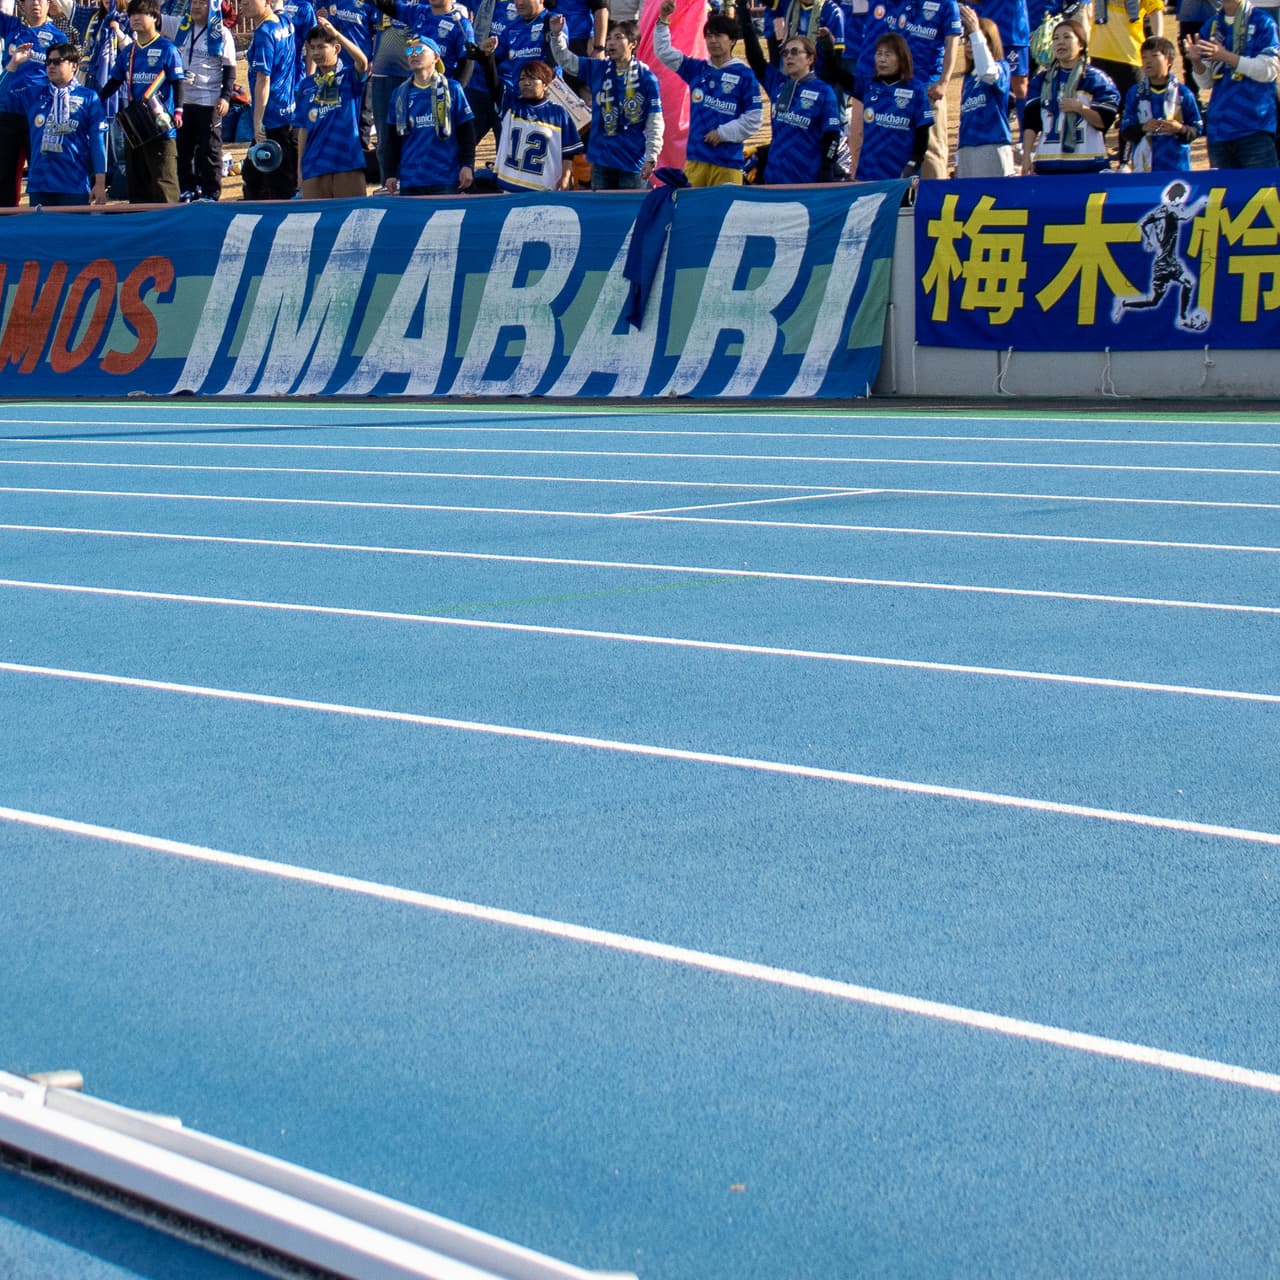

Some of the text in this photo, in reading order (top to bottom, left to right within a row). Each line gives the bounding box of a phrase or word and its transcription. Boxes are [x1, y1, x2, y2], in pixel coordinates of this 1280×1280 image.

[875, 112, 911, 126] unicharm
[503, 125, 548, 176] 12
[169, 192, 888, 398] IMABARI
